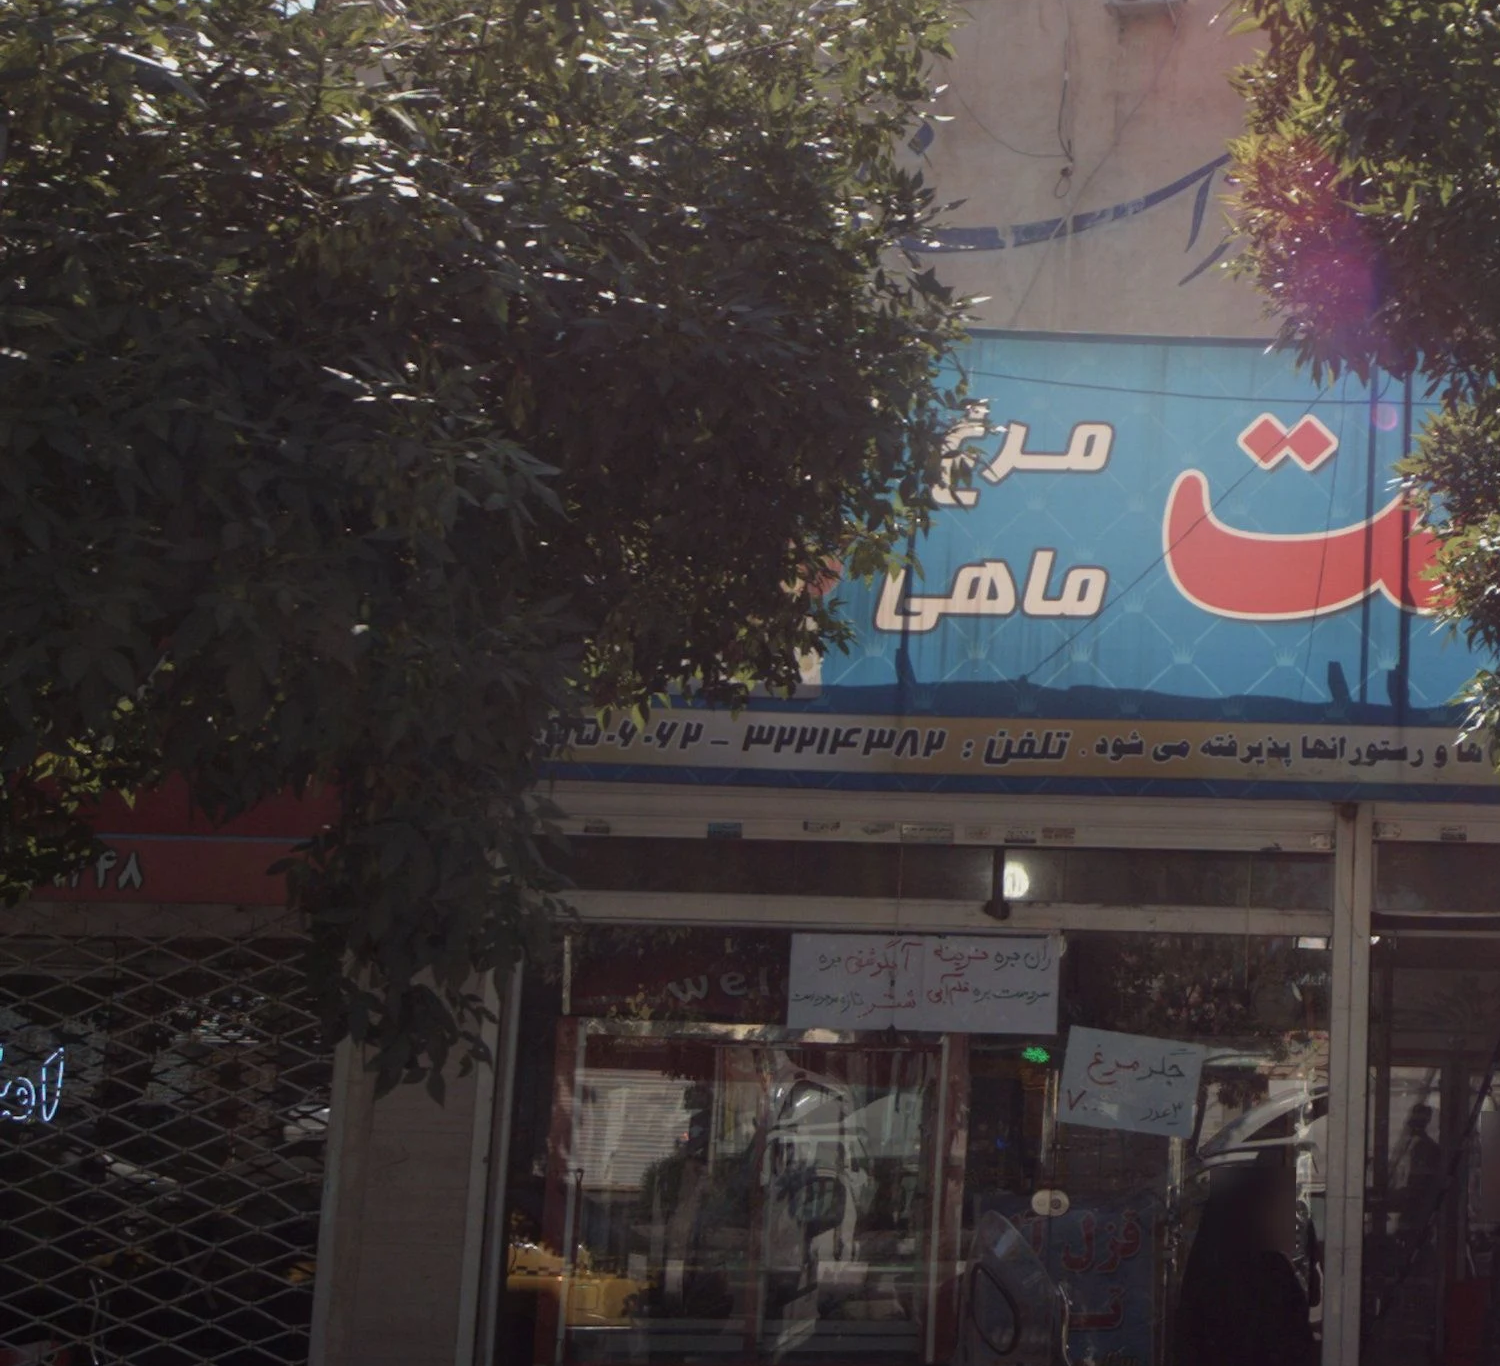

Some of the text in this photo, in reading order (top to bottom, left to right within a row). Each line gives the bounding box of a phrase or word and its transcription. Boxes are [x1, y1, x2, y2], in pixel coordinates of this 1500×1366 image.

[875, 548, 1108, 632] ماهی
[1152, 736, 1190, 763] می
[1200, 734, 1292, 767] پذیرفته
[1433, 746, 1449, 768] و
[1087, 1043, 1141, 1085] مرغ
